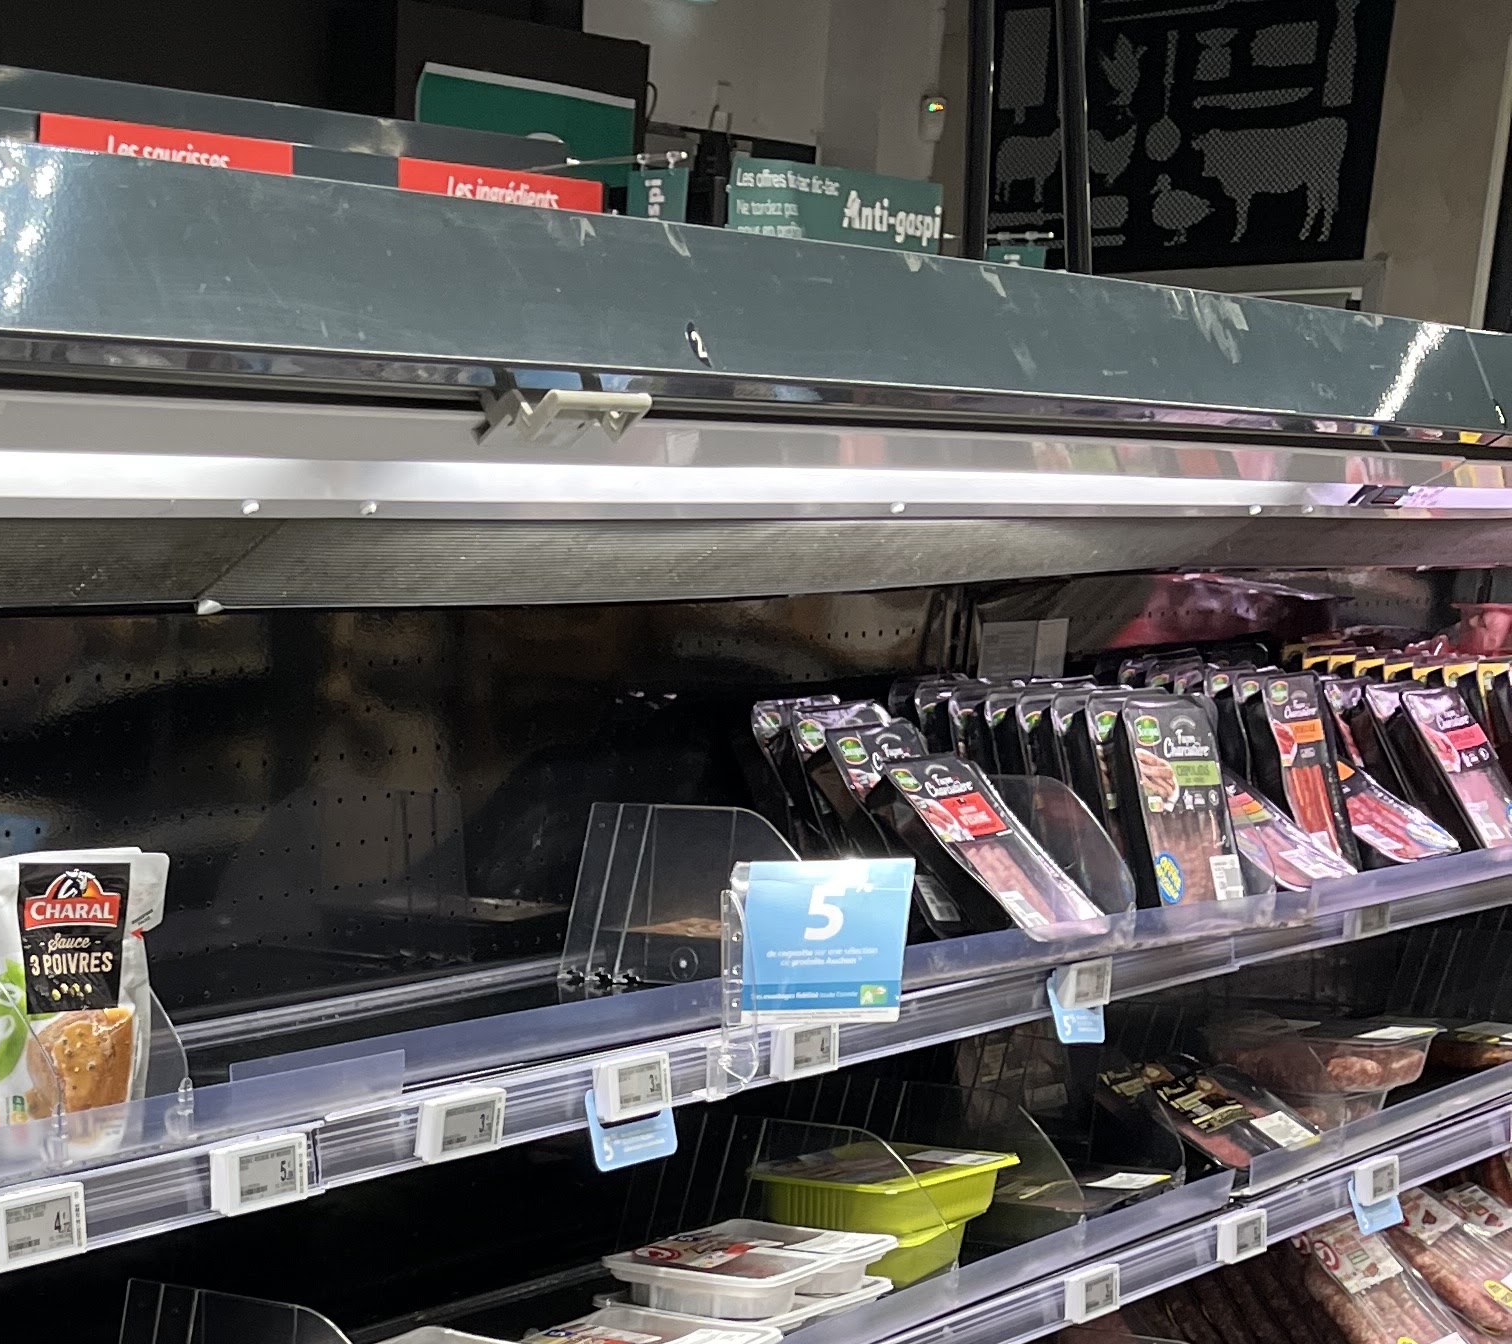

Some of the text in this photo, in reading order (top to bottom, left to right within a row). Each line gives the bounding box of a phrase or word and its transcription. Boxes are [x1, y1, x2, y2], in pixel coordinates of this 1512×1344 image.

[842, 190, 942, 247] Anti-gaspi
[29, 901, 114, 921] CHARAL
[804, 883, 845, 941] 5
[48, 933, 92, 952] Sauce
[29, 952, 113, 976] 3 POIVRES
